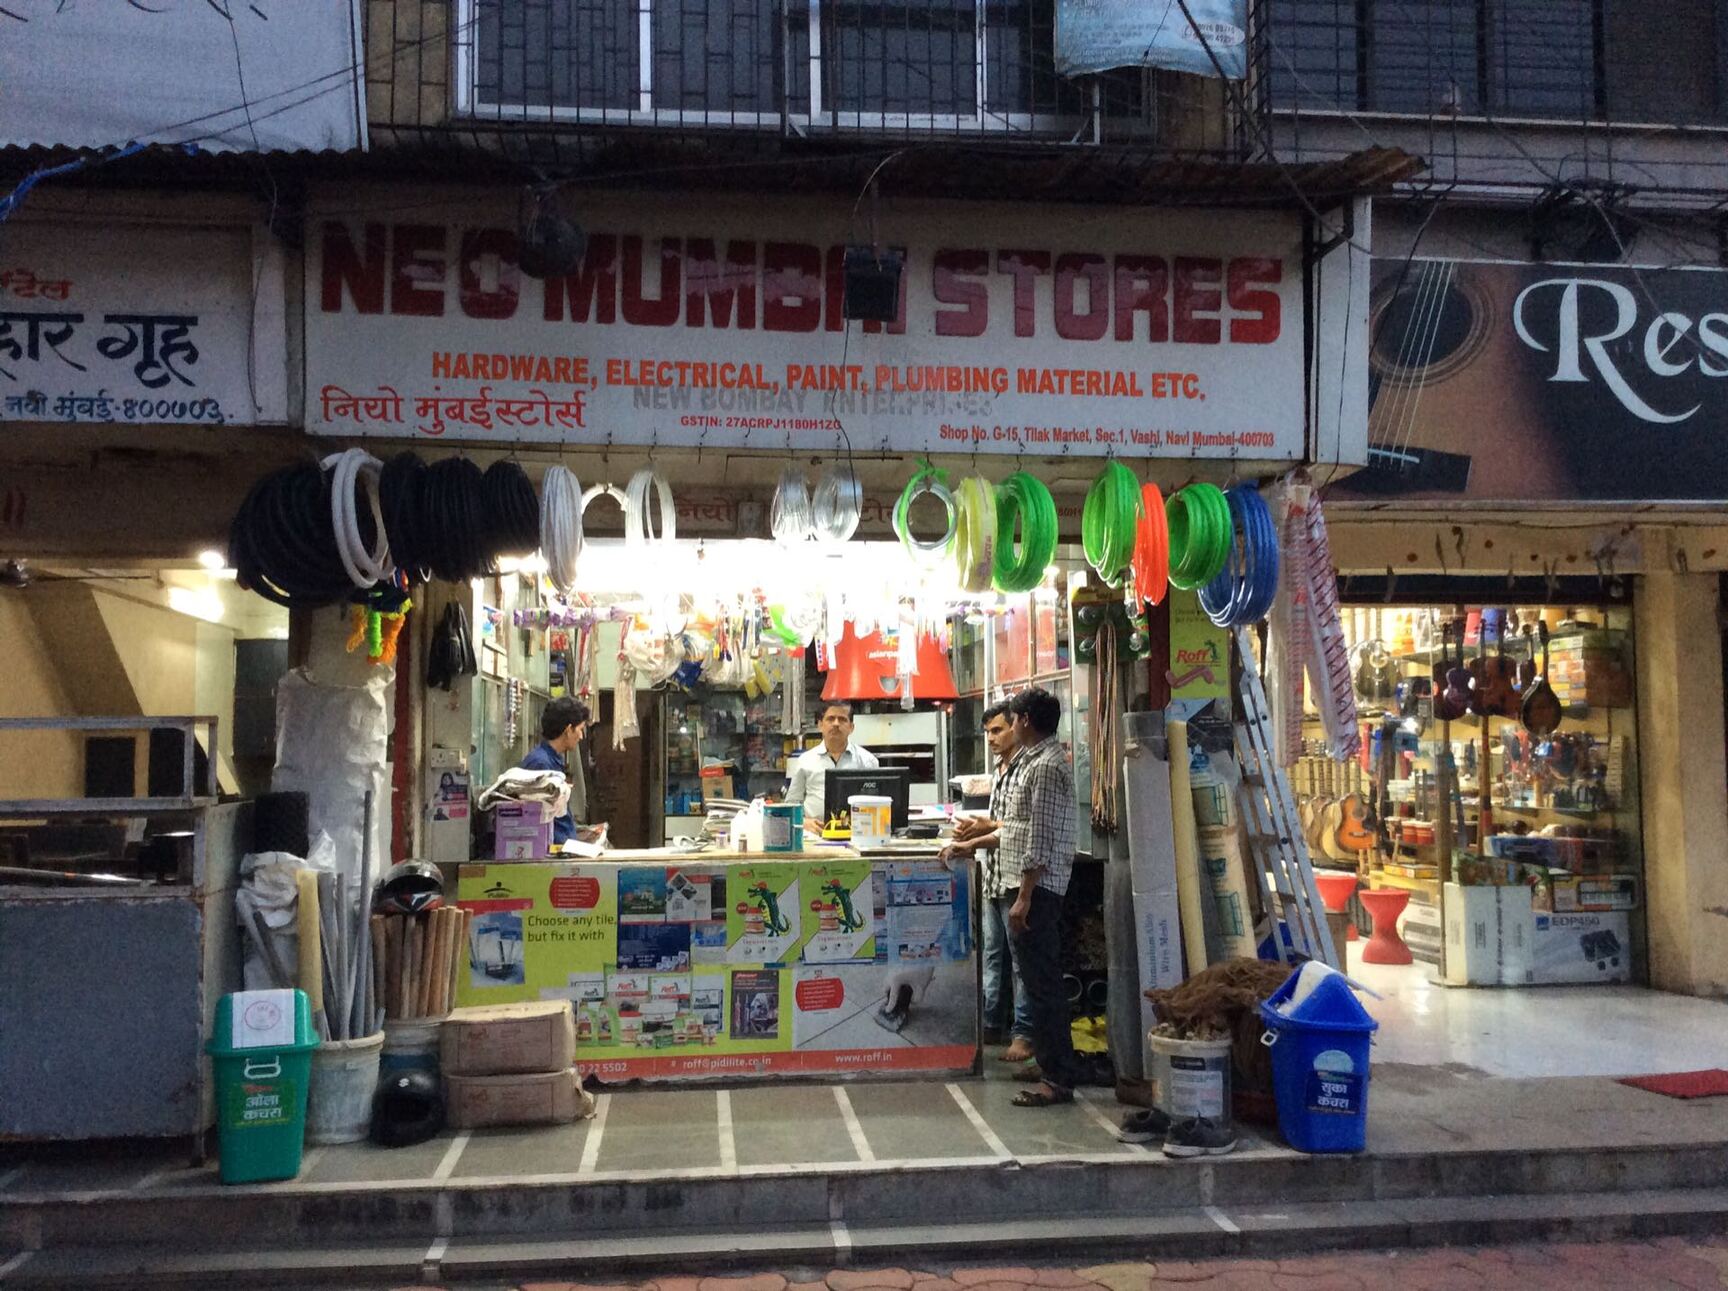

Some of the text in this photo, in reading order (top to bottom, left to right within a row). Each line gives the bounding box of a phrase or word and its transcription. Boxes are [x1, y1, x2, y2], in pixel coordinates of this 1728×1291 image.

[321, 221, 520, 320] NEO
[933, 249, 1282, 344] STORES
[97, 313, 199, 388] गृह
[1512, 277, 1728, 424] Res
[431, 351, 1206, 400] HARDWARE, ELECTRICAL, PAINT, PLUMBING MATERIAL ETC.
[320, 385, 404, 423] नियो
[700, 388, 808, 413] BOMBAY
[681, 415, 723, 428] GSTIN:
[939, 424, 1275, 448] Shop No. G-15, Tilak Market, Sec.1, Vashi, Navi Mumbai-400703
[1176, 648, 1210, 664] Roff
[528, 913, 617, 930] Choose any tile,
[527, 930, 604, 942] but fix it with
[589, 1064, 600, 1073] 22
[603, 1062, 627, 1073] 5502
[835, 1053, 892, 1064] www.roff.in
